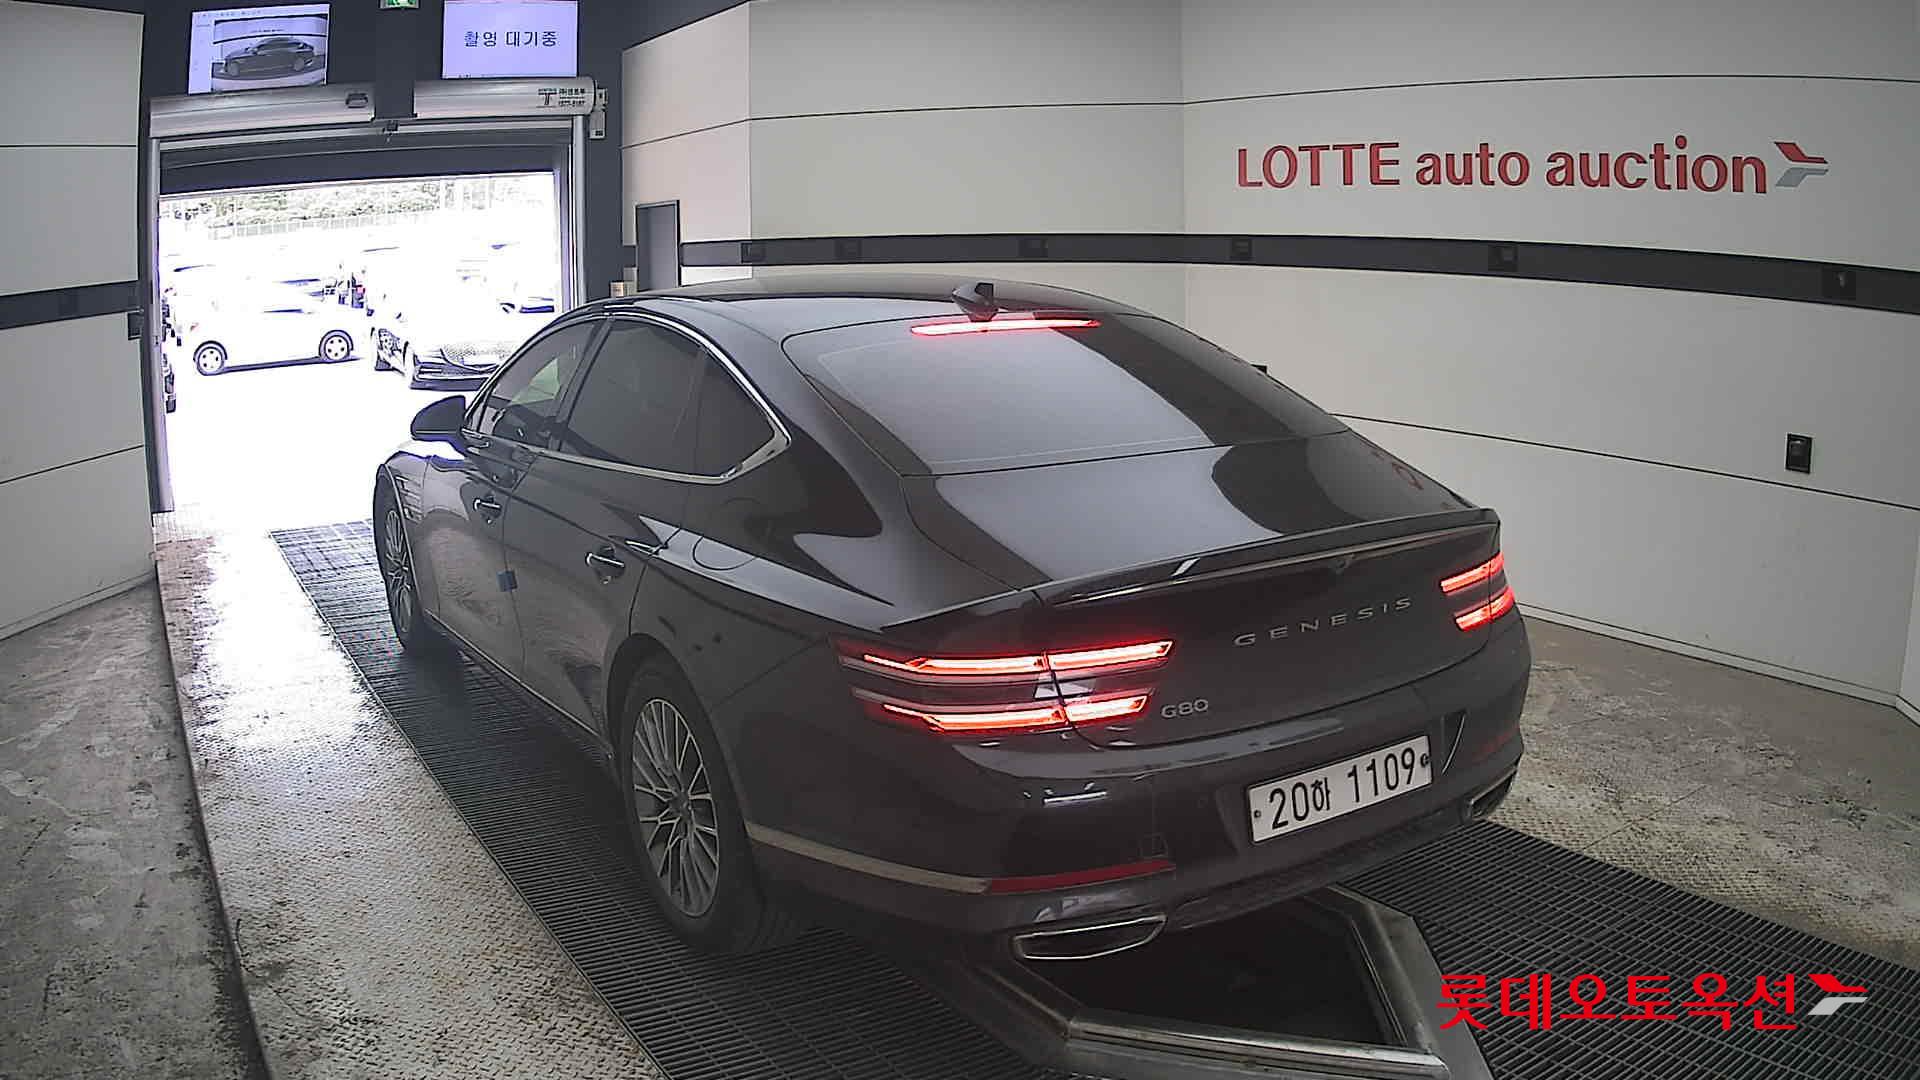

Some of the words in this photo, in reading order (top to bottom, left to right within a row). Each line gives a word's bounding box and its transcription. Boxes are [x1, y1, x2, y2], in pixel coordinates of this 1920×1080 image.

[464, 31, 497, 47] 촬영
[505, 31, 558, 47] 대기중
[1238, 142, 1400, 188] LOTTE
[1415, 143, 1530, 187] auto
[1546, 135, 1767, 194] auction
[1234, 597, 1412, 646] GENESIS
[1161, 699, 1209, 718] G80
[1269, 776, 1331, 830] 20하
[1347, 747, 1416, 803] 1109
